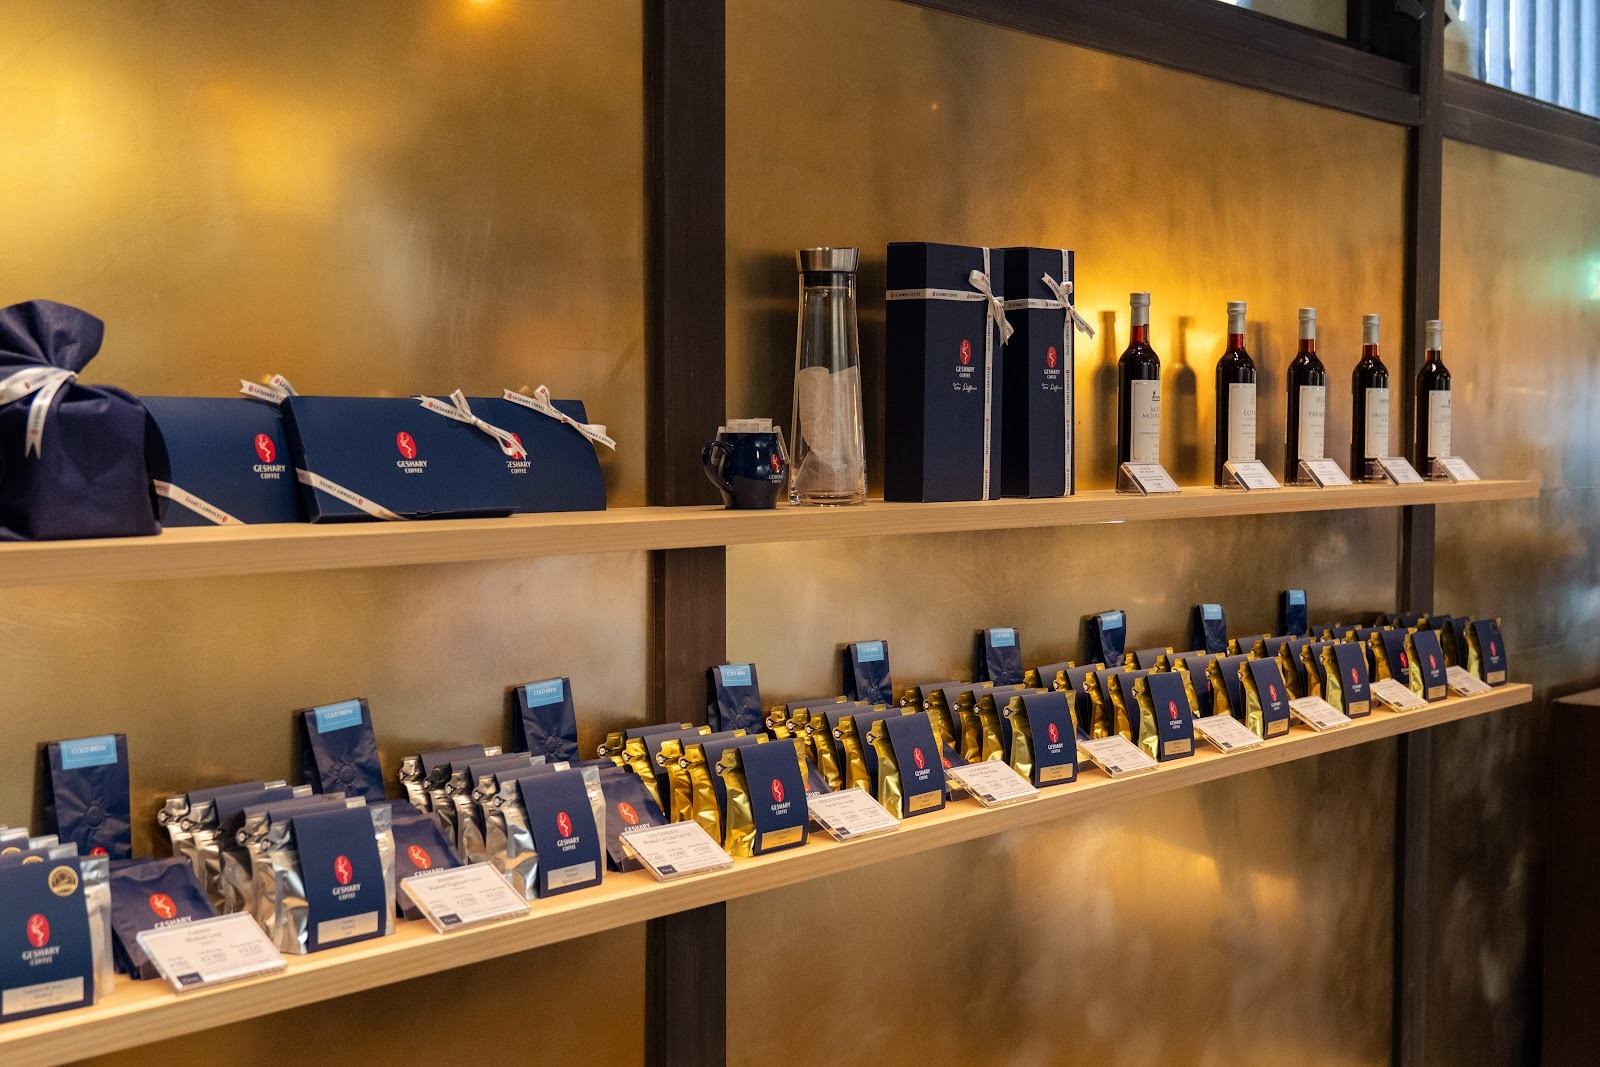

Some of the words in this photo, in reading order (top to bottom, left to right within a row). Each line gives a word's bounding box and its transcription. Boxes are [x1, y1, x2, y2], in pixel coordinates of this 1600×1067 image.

[253, 464, 286, 473] GESHARY
[396, 460, 428, 468] GESHARY
[260, 472, 281, 480] COFFEE
[534, 688, 545, 696] COLD
[324, 712, 339, 720] COLD
[340, 708, 353, 717] BREW
[71, 746, 89, 755] COLD
[90, 744, 107, 752] BREW
[1048, 742, 1064, 750] GESHARY
[914, 768, 931, 777] GESHARY
[770, 802, 791, 812] GESHARY
[556, 836, 580, 848] GESHARY
[332, 882, 362, 896] GESHARY
[22, 945, 60, 961] GESHARY
